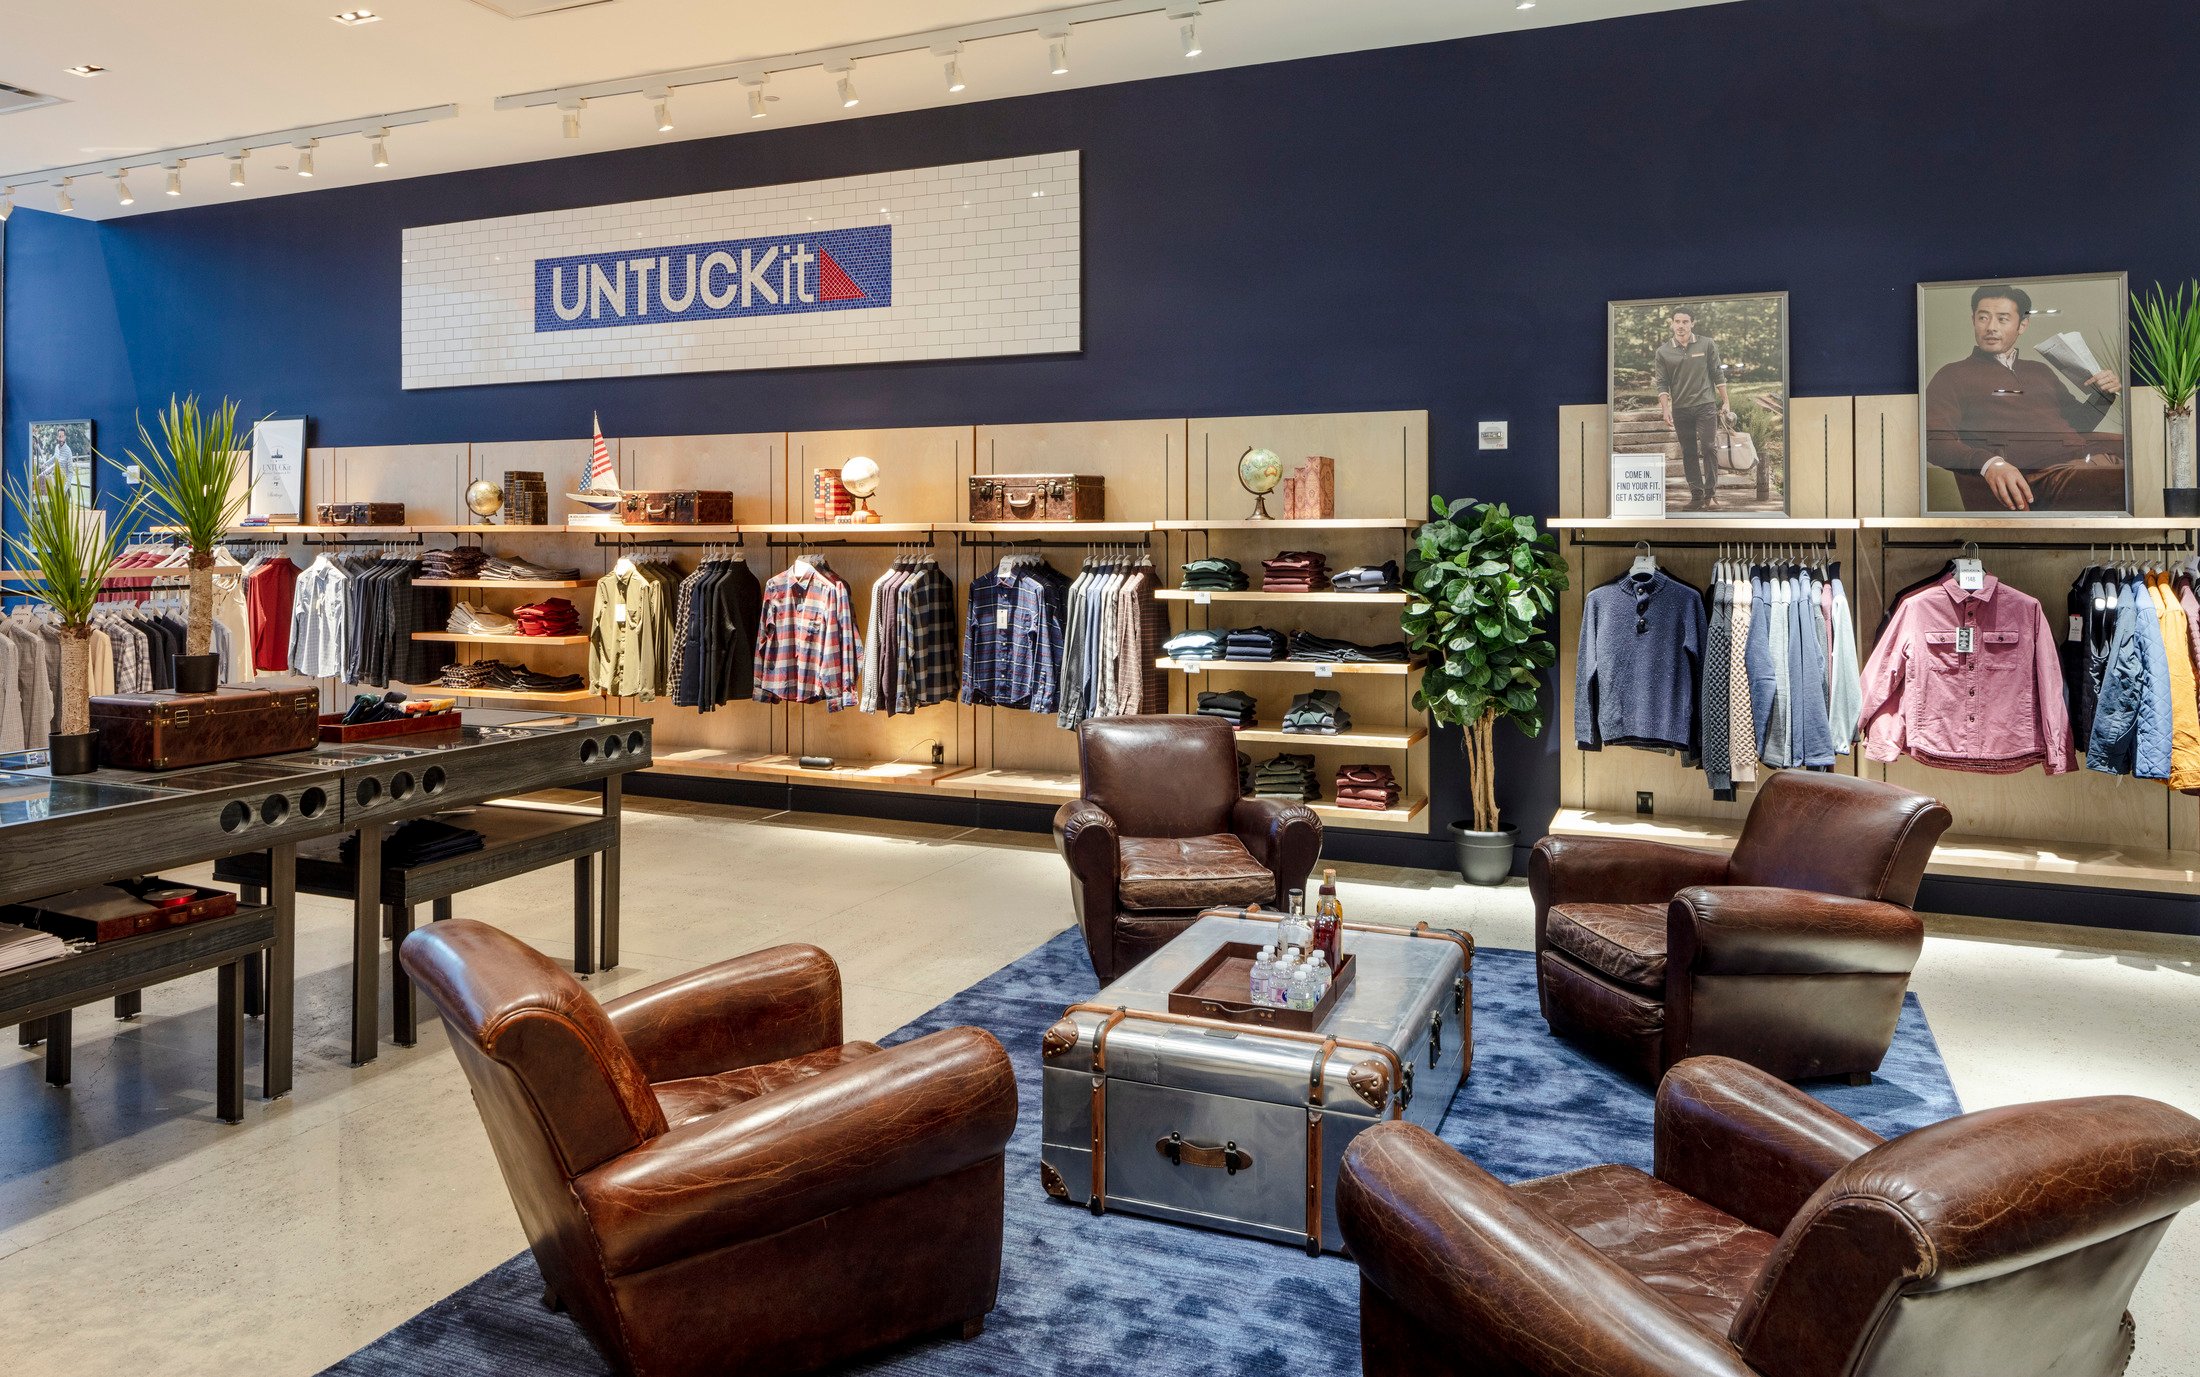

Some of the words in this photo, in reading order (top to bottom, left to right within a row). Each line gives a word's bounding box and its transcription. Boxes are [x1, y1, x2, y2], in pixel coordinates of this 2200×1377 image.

[552, 243, 815, 321] UNTUCKit
[1624, 470, 1642, 479] COME
[1643, 470, 1652, 479] IN.
[1616, 482, 1631, 490] FIND
[1631, 482, 1649, 490] YOUR
[1649, 481, 1661, 490] FIT.
[1615, 493, 1627, 502] GET
[1627, 493, 1633, 502] A
[1633, 493, 1645, 502] $25
[1646, 493, 1662, 502] GIFT!
